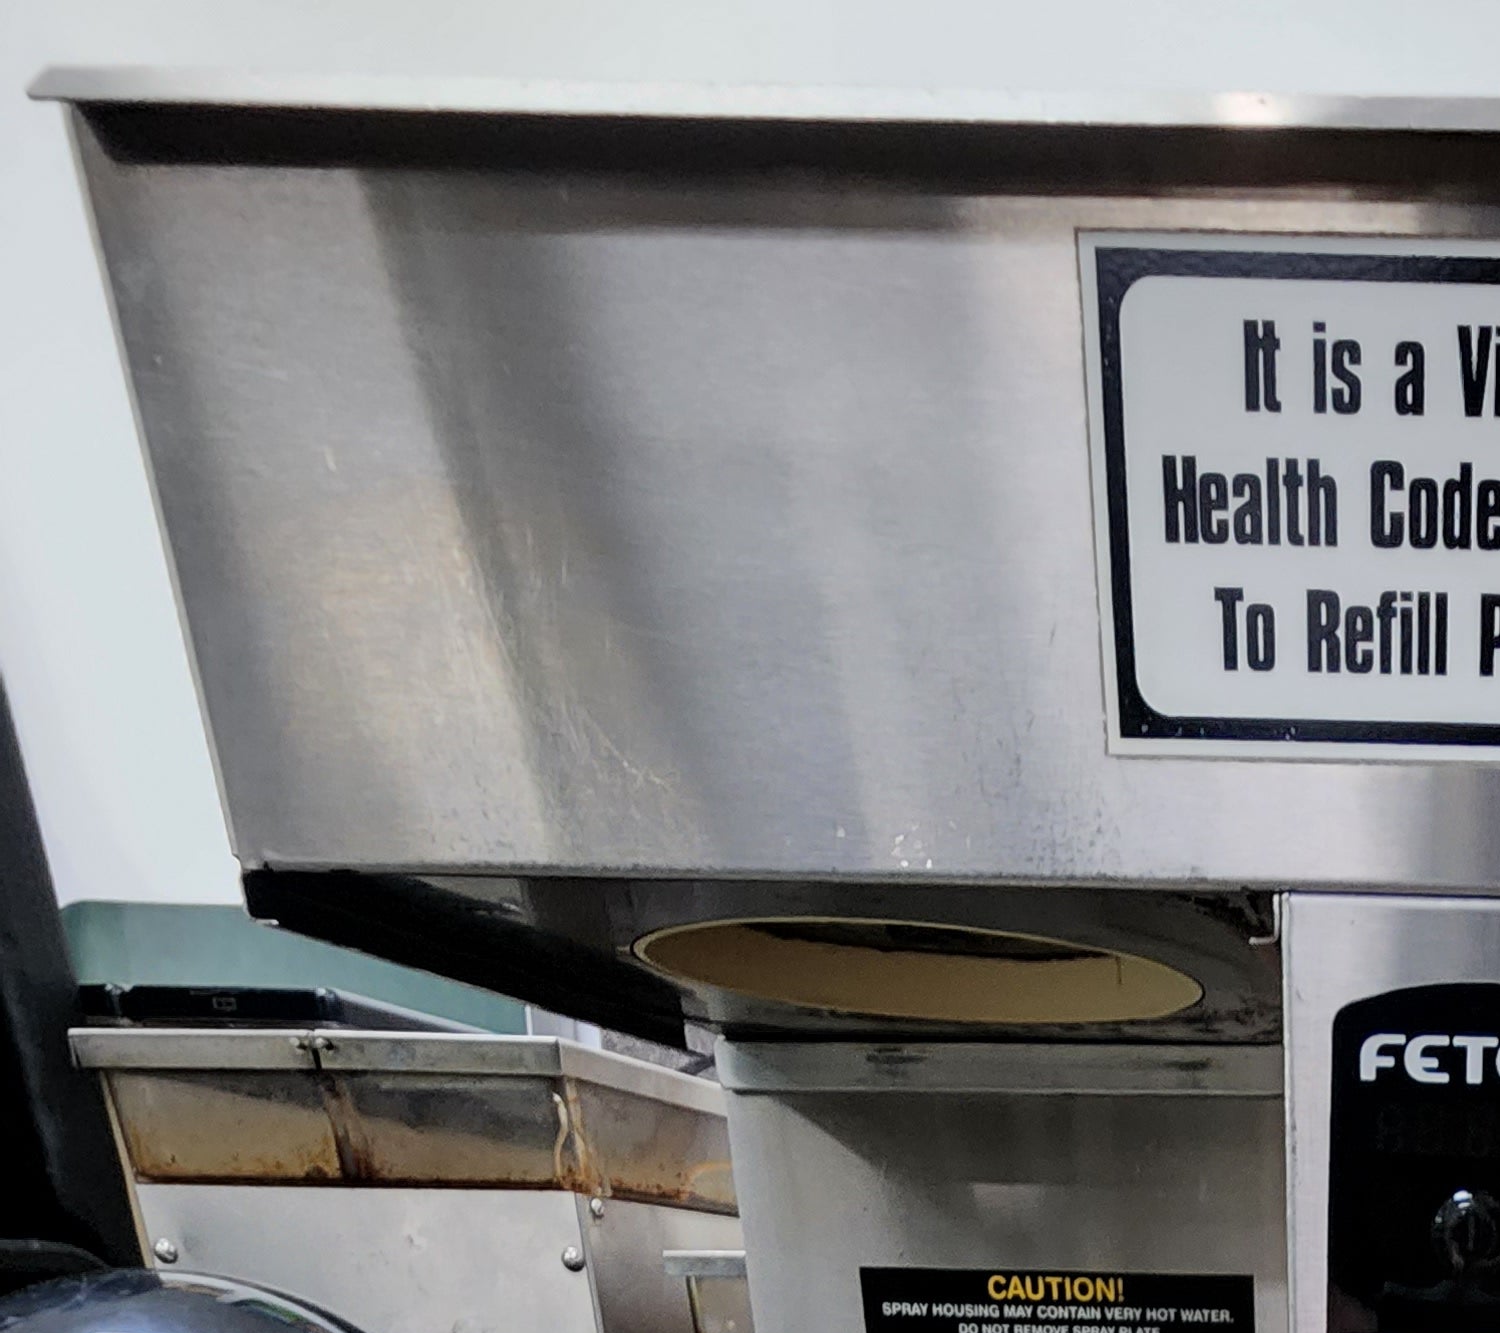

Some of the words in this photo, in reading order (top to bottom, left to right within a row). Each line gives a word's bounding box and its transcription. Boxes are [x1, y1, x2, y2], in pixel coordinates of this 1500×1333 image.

[1242, 318, 1282, 415] It
[1312, 321, 1362, 416] is
[1394, 339, 1425, 417] a
[1161, 455, 1338, 547] Health
[1213, 587, 1275, 671] To
[1306, 590, 1448, 676] Refill
[881, 1302, 928, 1317] SPRAY
[931, 1303, 1000, 1318] HOUSING
[1002, 1304, 1033, 1319] MAY
[1036, 1305, 1101, 1320] CONTAIN
[1104, 1306, 1142, 1321] VERY
[1145, 1307, 1176, 1322] HOT
[987, 1275, 1124, 1302] CAUTION!
